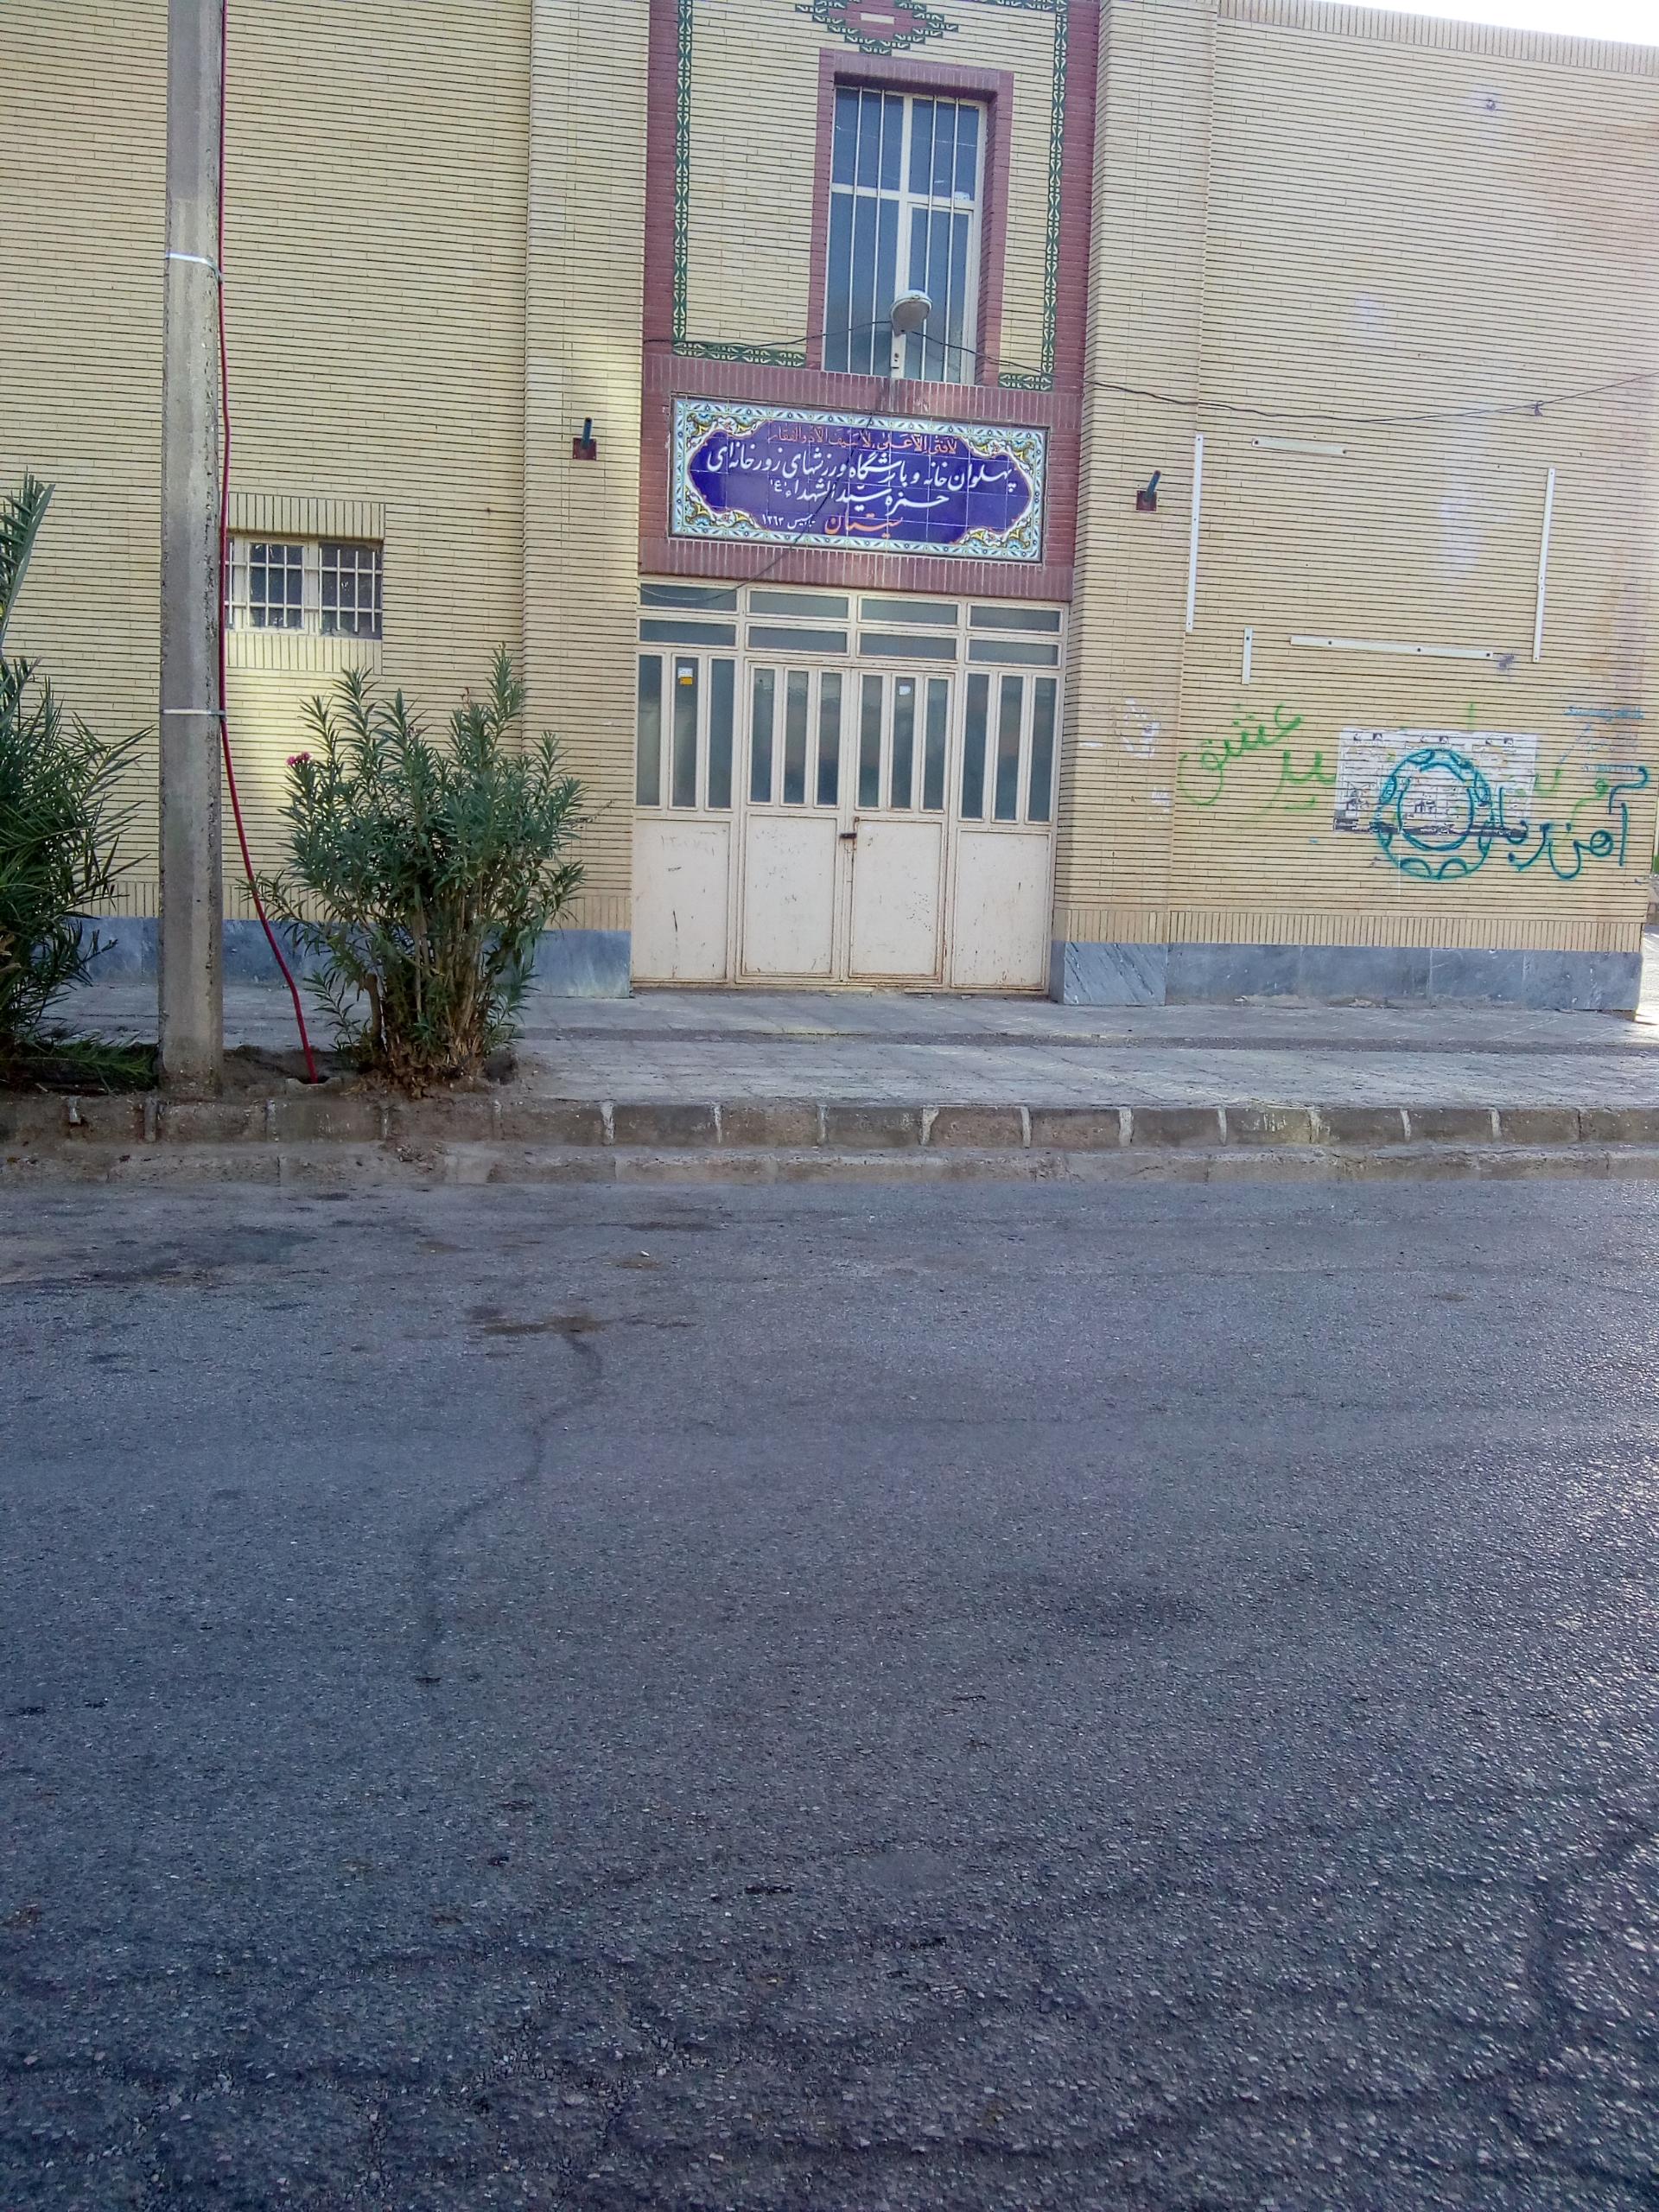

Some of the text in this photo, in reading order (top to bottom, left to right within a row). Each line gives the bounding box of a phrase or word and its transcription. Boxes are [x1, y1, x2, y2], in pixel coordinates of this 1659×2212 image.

[849, 452, 906, 487] باشگاه
[885, 492, 950, 517] حمزه
[1180, 703, 1303, 805] عشق
